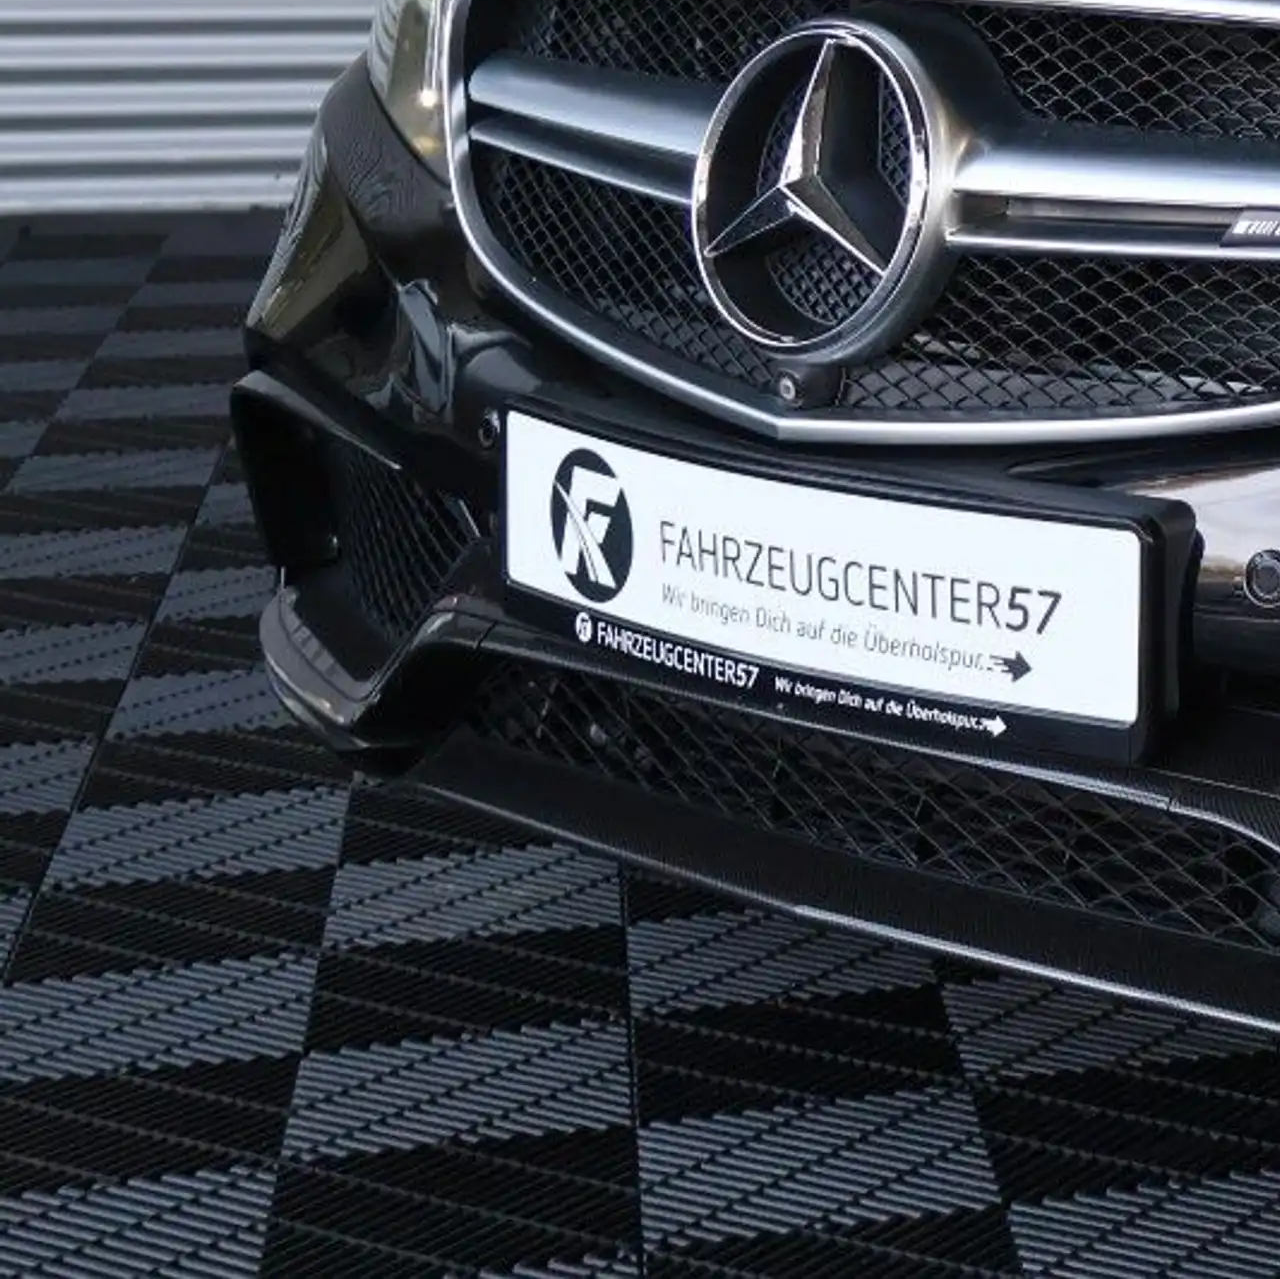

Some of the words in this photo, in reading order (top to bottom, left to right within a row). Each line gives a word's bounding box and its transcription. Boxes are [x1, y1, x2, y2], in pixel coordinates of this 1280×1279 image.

[660, 520, 1062, 635] FAHRZEUGCENTER57
[662, 583, 686, 608] Wir
[691, 591, 750, 625] bringen
[756, 607, 792, 634] Dich
[797, 619, 825, 640] auf
[831, 624, 858, 647] die
[597, 622, 760, 689] FAHRZEUGCENTER57
[775, 676, 792, 694] Wir
[864, 696, 884, 713] auf
